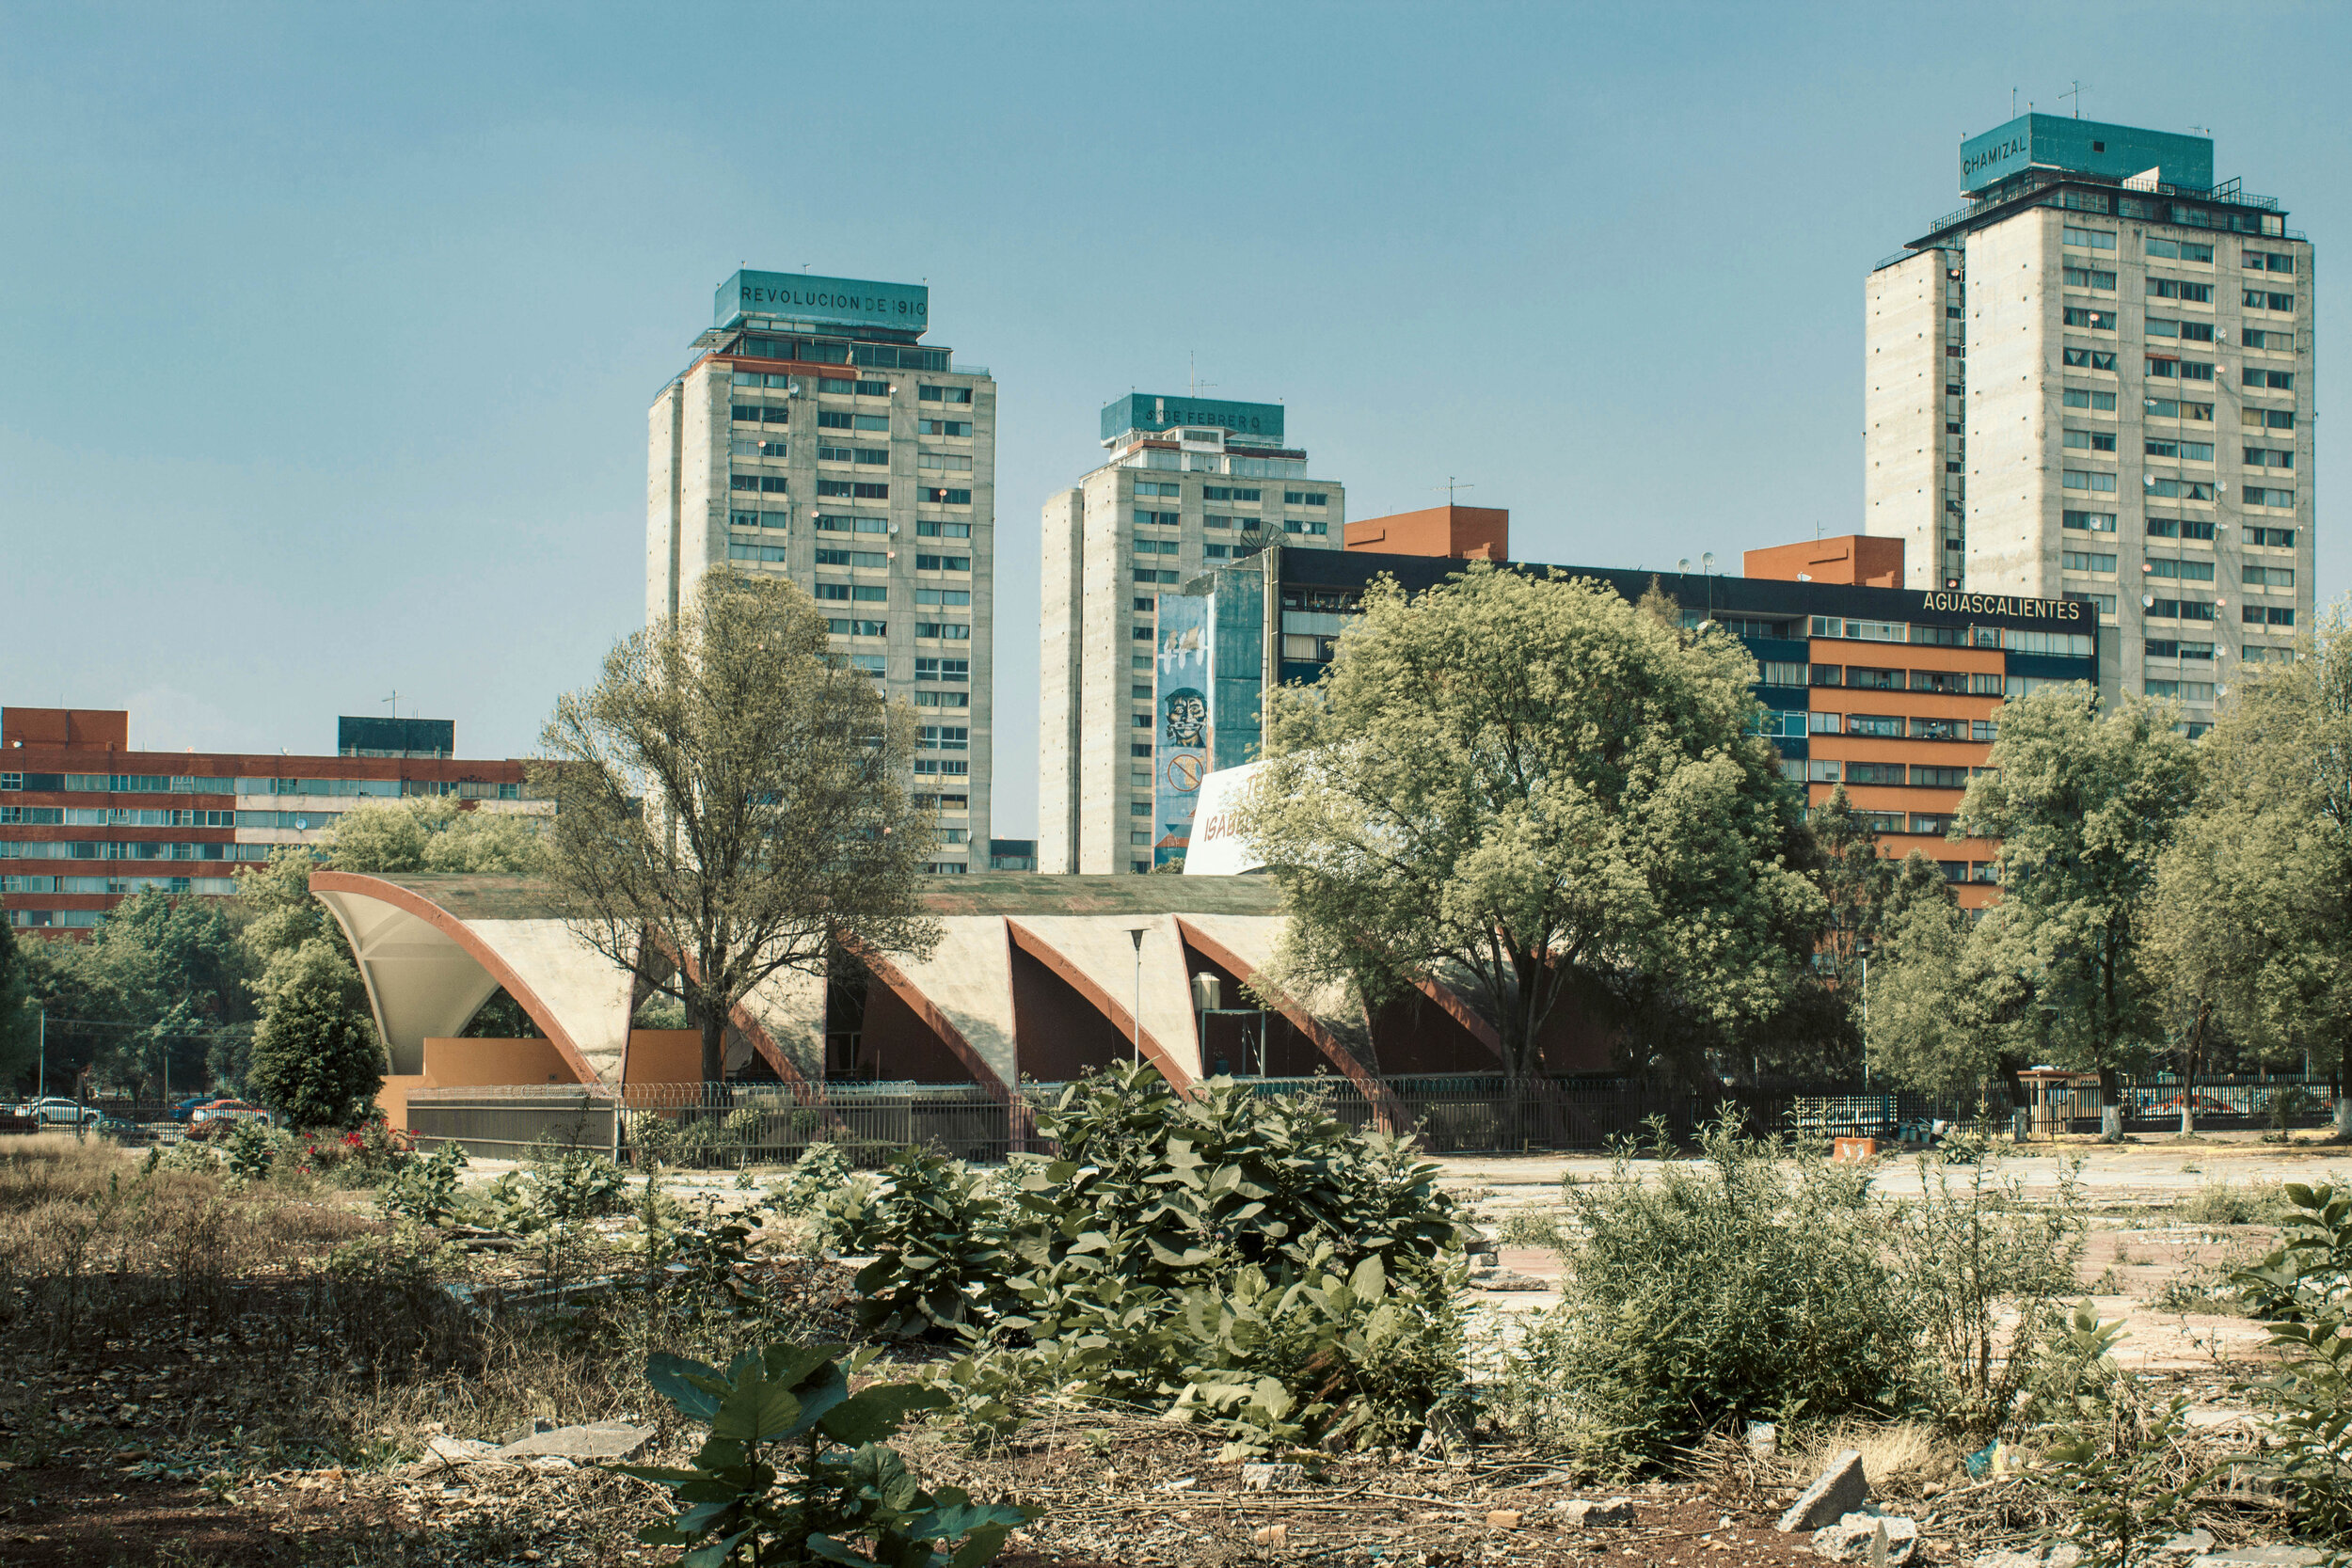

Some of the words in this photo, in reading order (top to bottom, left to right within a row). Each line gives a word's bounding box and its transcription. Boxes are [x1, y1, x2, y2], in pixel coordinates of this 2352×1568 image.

[1963, 136, 2026, 176] CHAMIZAL
[741, 286, 860, 310] REVOLUCION
[865, 297, 887, 312] DE
[892, 299, 927, 316] 1910
[1163, 410, 1181, 422] DE
[1187, 412, 1261, 428] FEBRERO
[1923, 592, 2080, 620] AGUASCALIENTES
